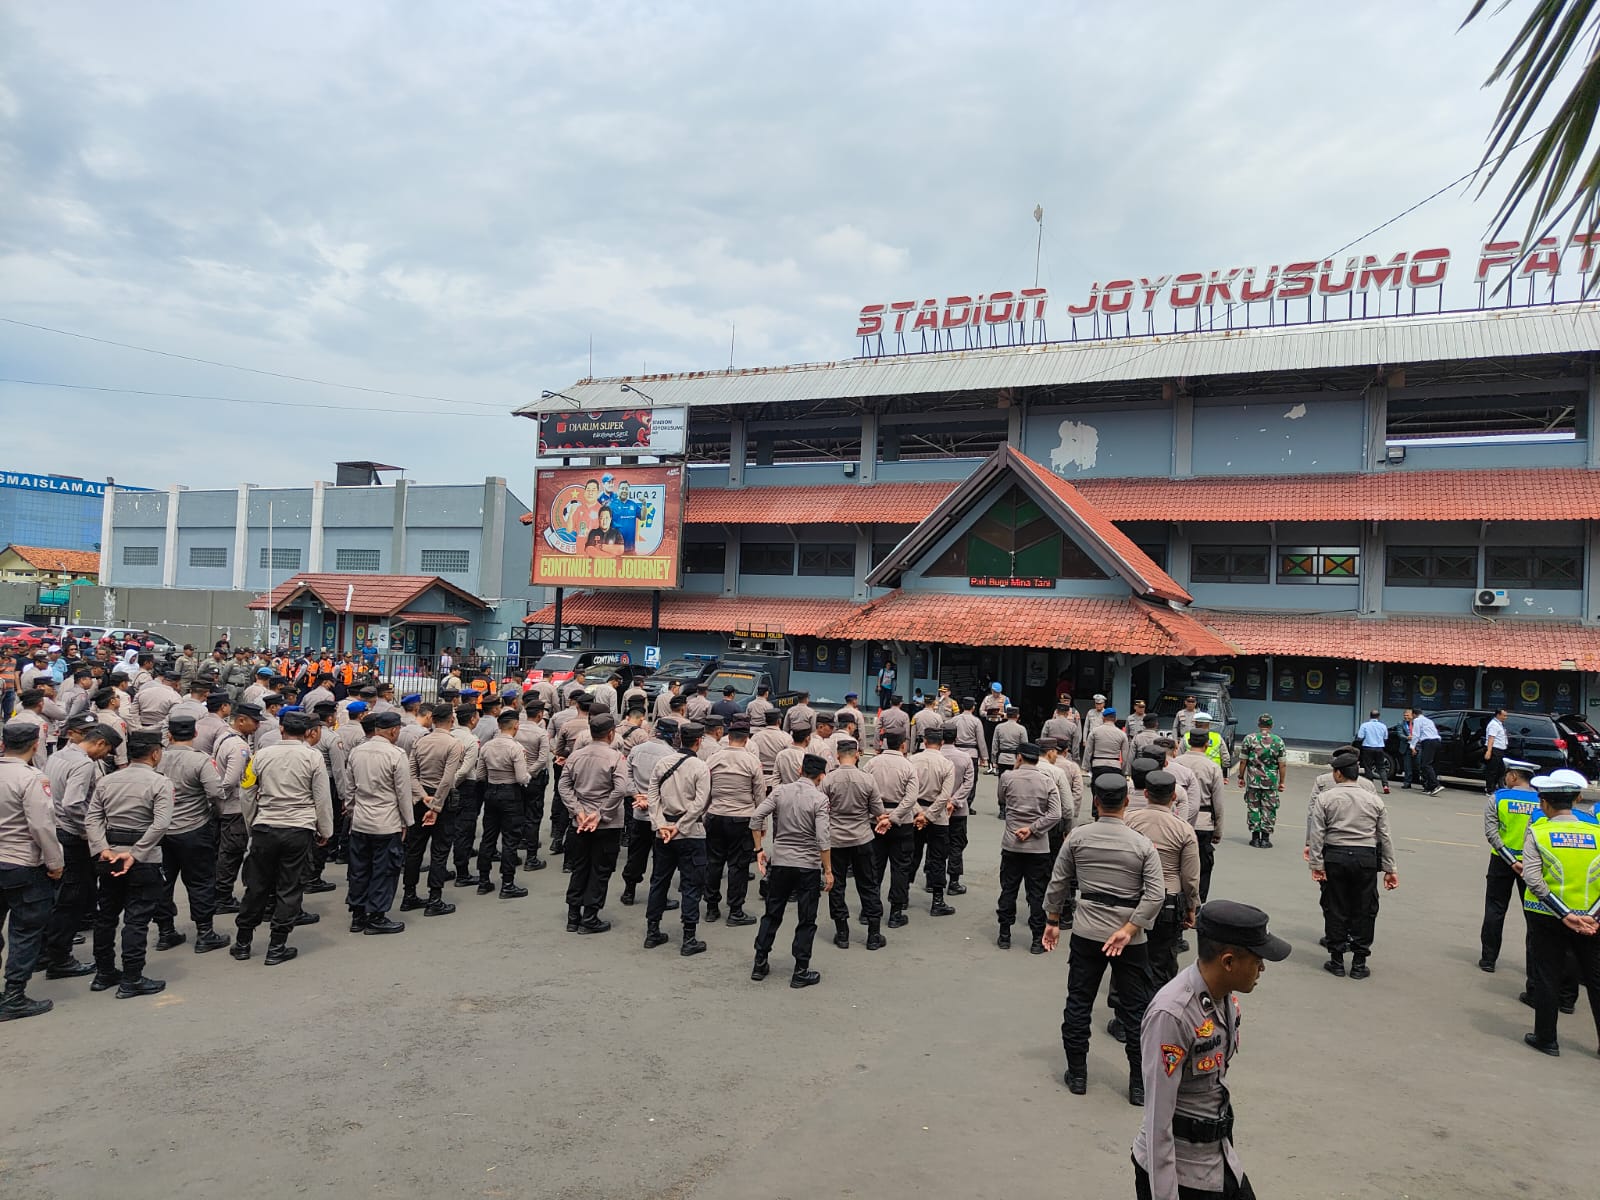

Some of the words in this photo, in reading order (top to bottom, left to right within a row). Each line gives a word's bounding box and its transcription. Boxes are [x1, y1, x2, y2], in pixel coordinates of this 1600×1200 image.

[1067, 248, 1451, 317] JOYOKUSUMO
[569, 422, 600, 432] DJARUM
[601, 421, 624, 431] SUPER
[651, 491, 657, 499] 2
[541, 557, 592, 578] CONTINUE
[593, 557, 617, 578] OUR
[618, 558, 671, 580] JOURNEY
[970, 577, 986, 585] Pati
[1010, 578, 1031, 587] Mina
[1034, 579, 1051, 587] Tani
[647, 648, 656, 660] P
[778, 697, 794, 706] POLISI
